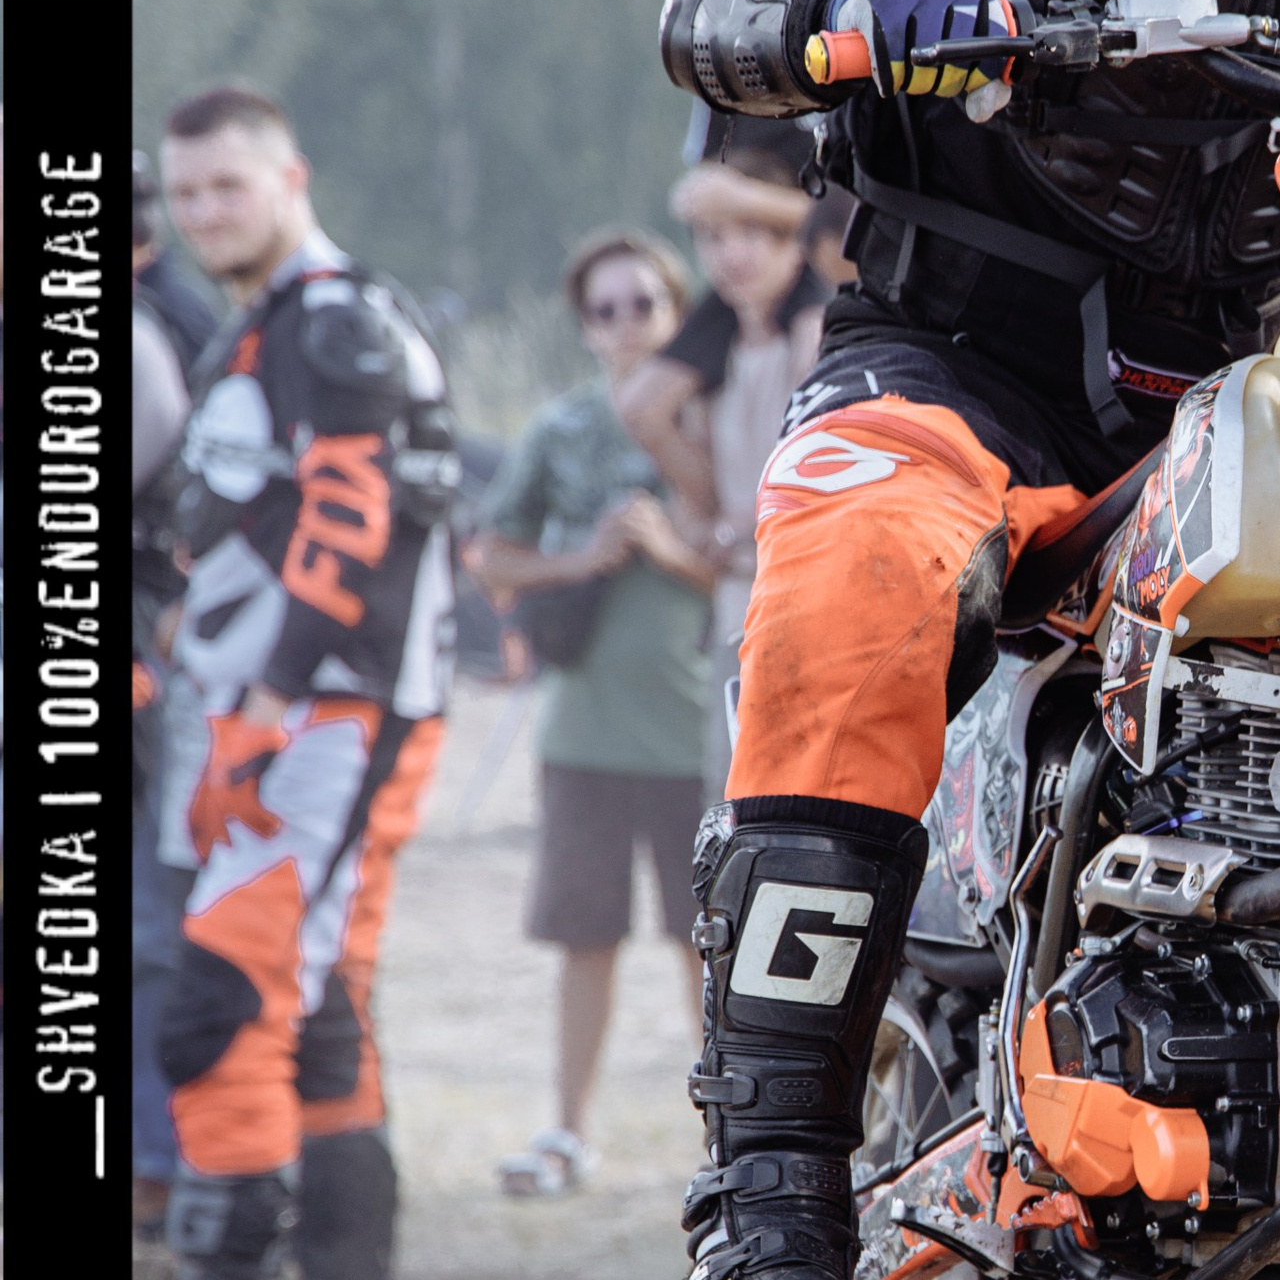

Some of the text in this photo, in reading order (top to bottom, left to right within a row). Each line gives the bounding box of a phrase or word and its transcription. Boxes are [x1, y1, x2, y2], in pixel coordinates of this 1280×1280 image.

[281, 432, 393, 628] FOX
[1136, 565, 1172, 608] MOLY
[729, 881, 875, 1006] G
